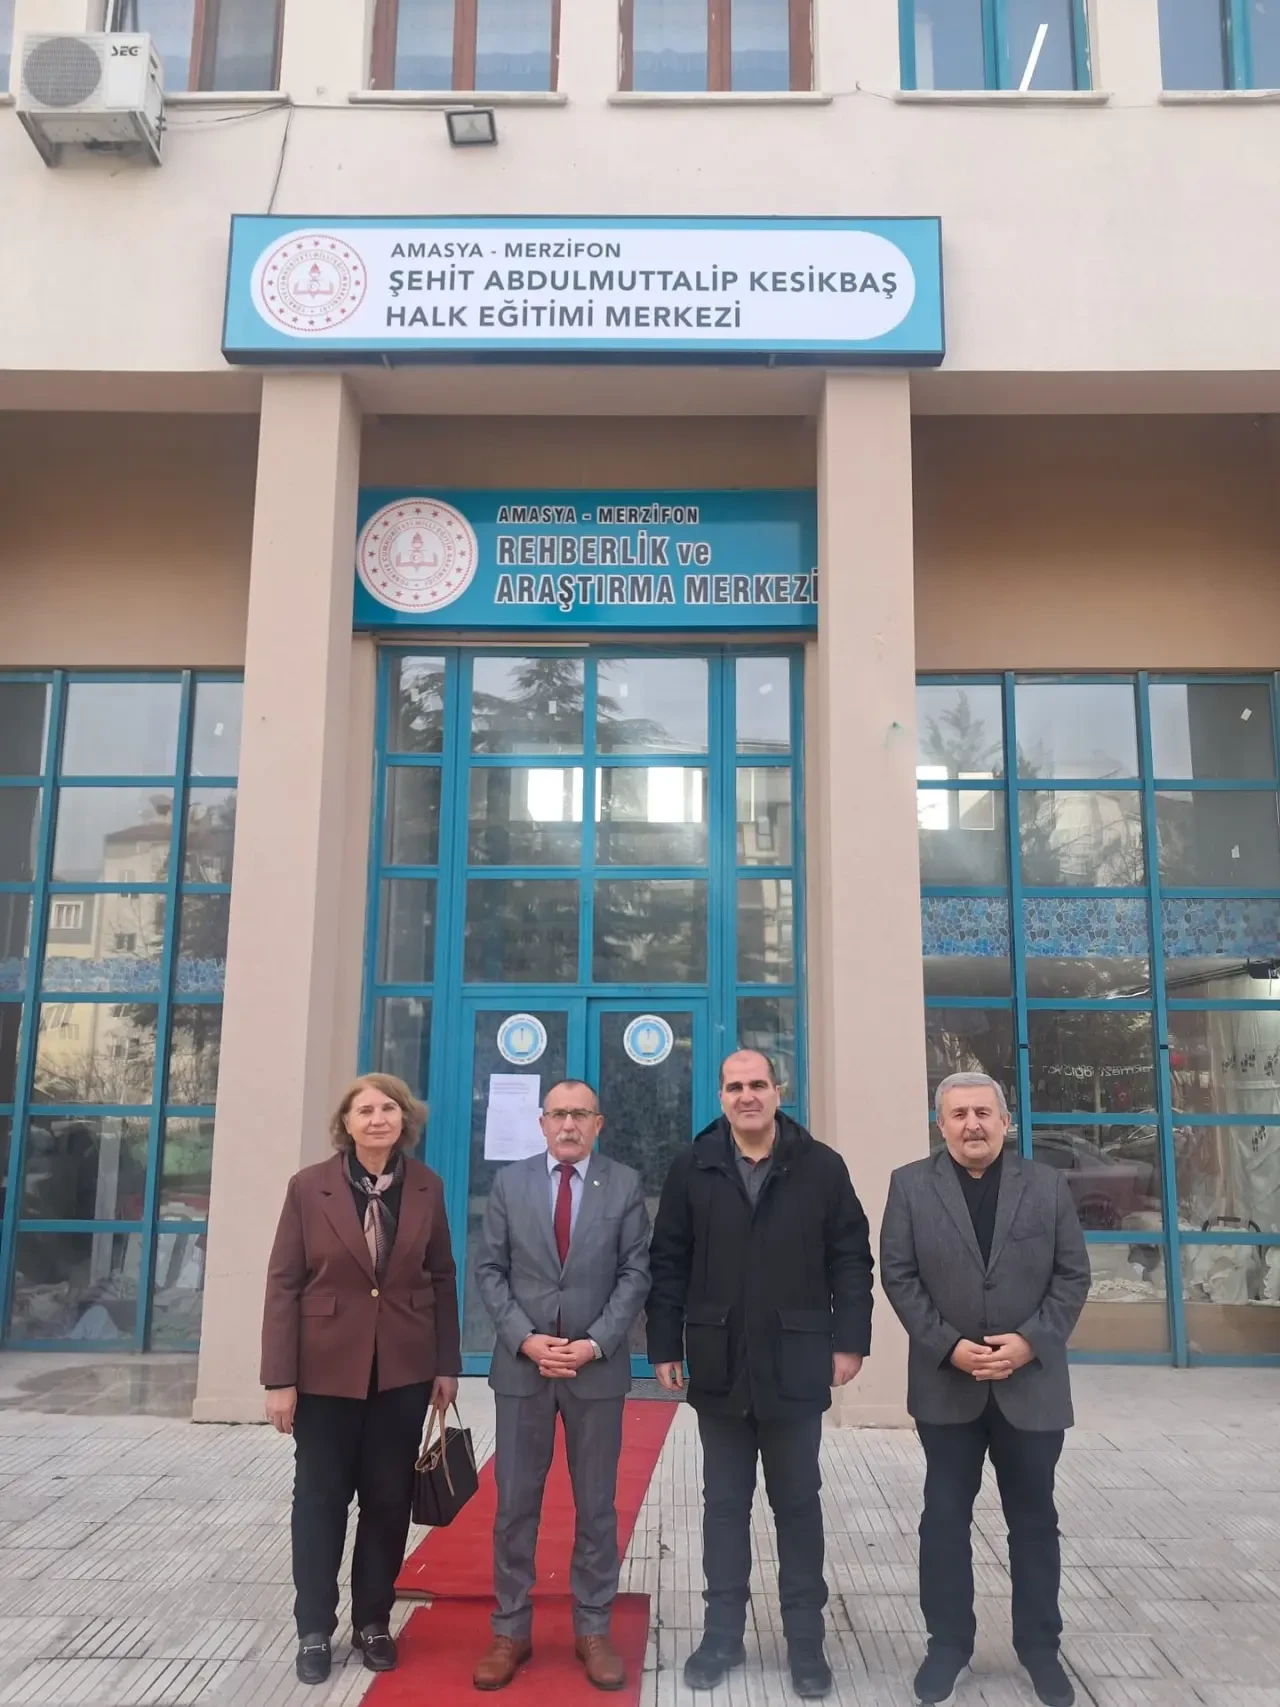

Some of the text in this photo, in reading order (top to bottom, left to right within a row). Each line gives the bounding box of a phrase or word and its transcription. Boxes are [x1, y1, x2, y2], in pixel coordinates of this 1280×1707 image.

[111, 45, 139, 57] SEG
[390, 242, 484, 258] AMASYA
[504, 237, 621, 259] MERZİFON
[388, 263, 475, 298] ŞEHİT
[483, 263, 739, 292] ABDULMUTTALİP
[749, 264, 898, 300] KESİKBAŞ
[386, 298, 741, 328] HALK EĞİTİMİ MERKEZİ
[497, 506, 577, 524] AMASYA
[597, 503, 699, 524] MERZİFON
[497, 530, 711, 566] REHBERLİK ve
[494, 568, 818, 612] ARAŞTIRMA MERKEZİ
